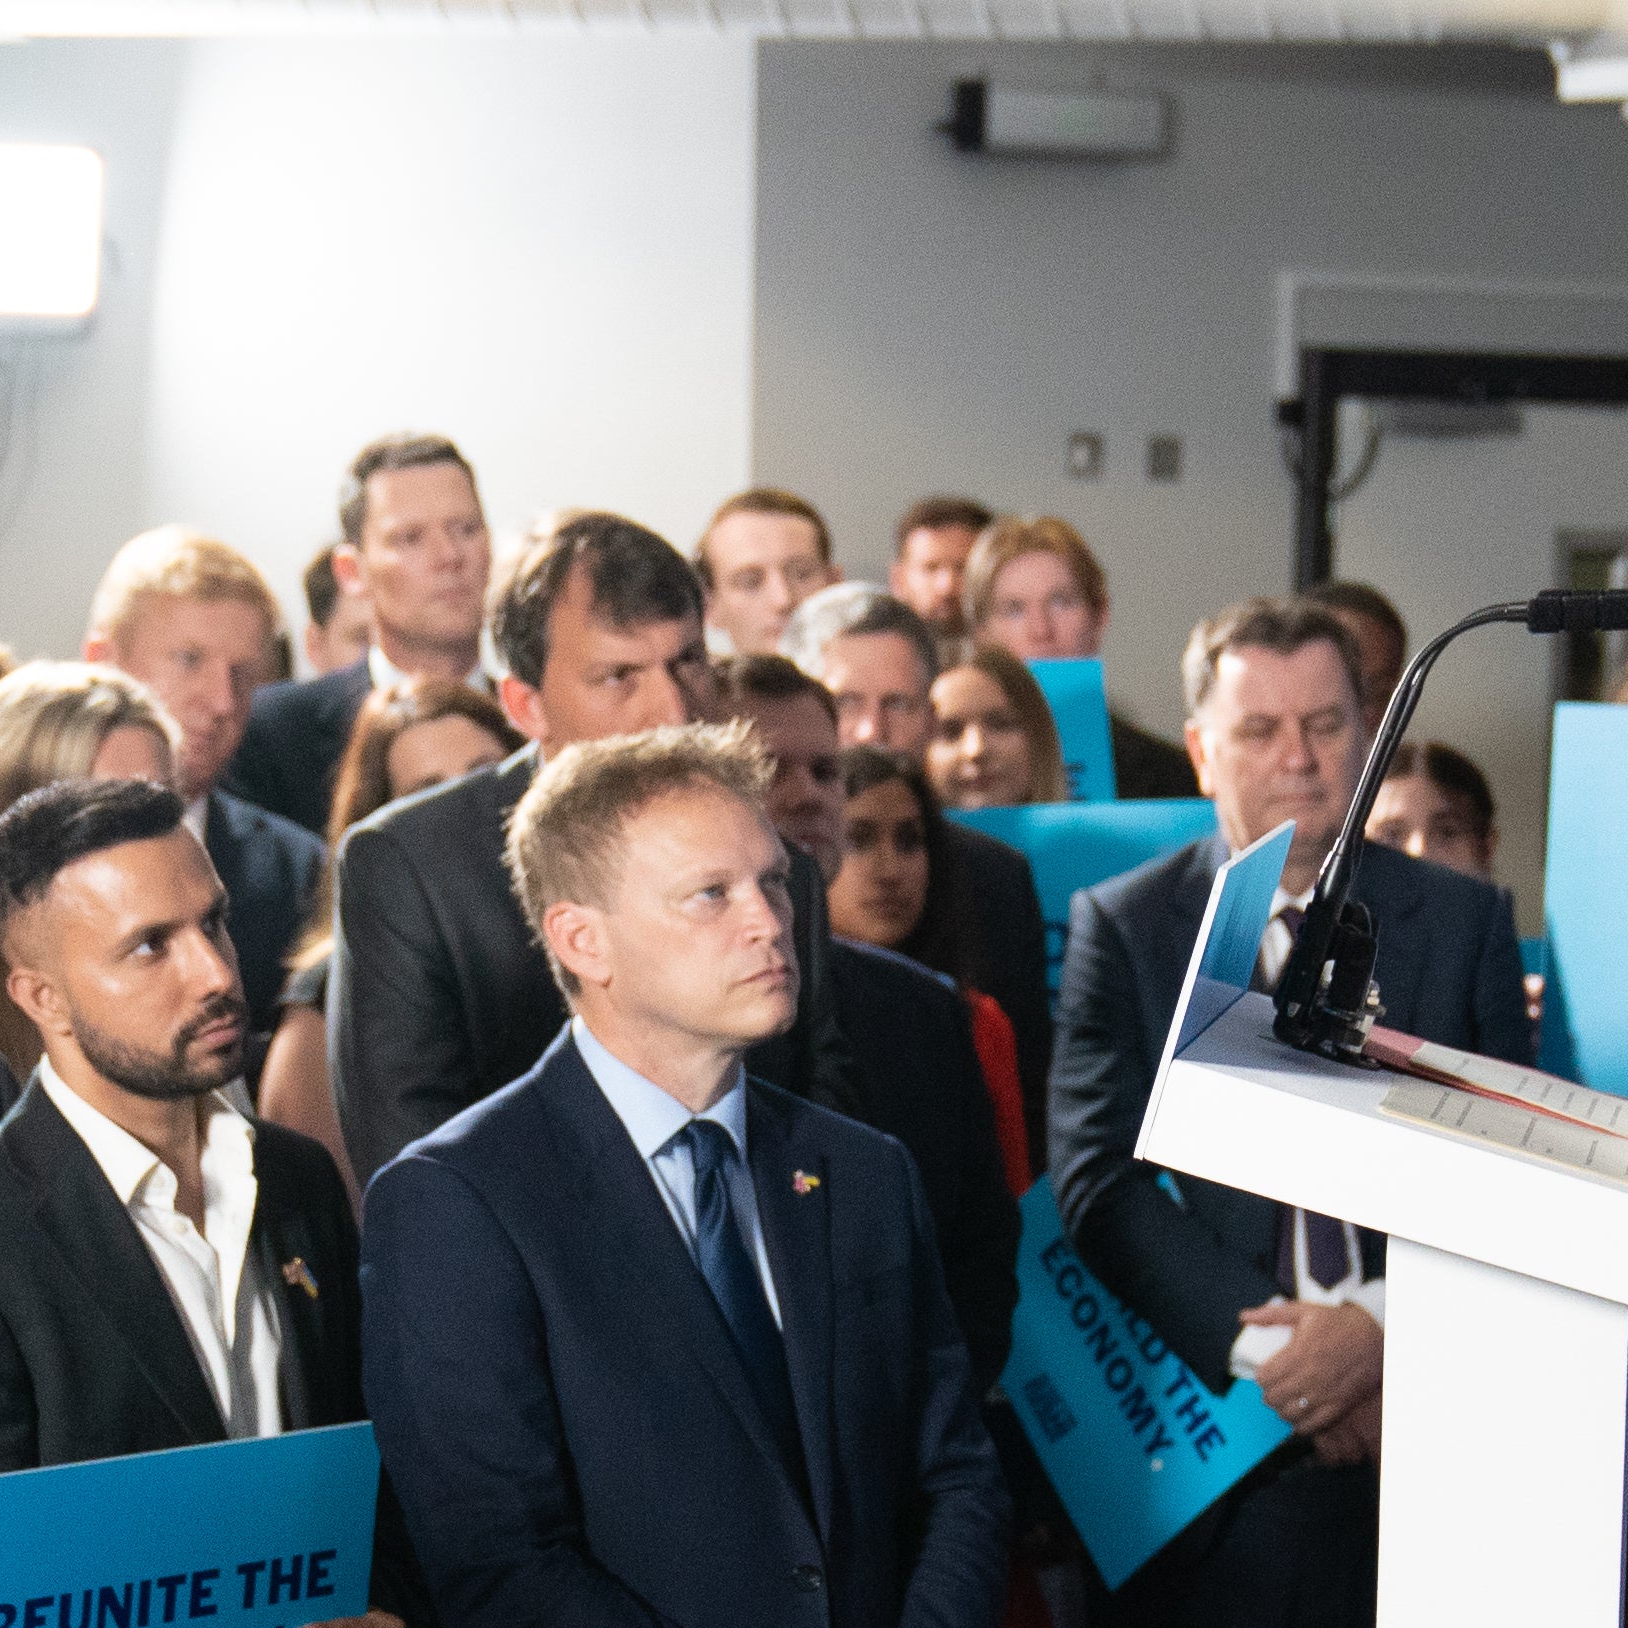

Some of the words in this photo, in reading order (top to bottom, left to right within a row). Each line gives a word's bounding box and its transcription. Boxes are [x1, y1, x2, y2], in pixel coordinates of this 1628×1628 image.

[1039, 1236, 1175, 1457] ECONOMY
[1164, 1364, 1227, 1463] THE
[237, 1549, 338, 1606] THE
